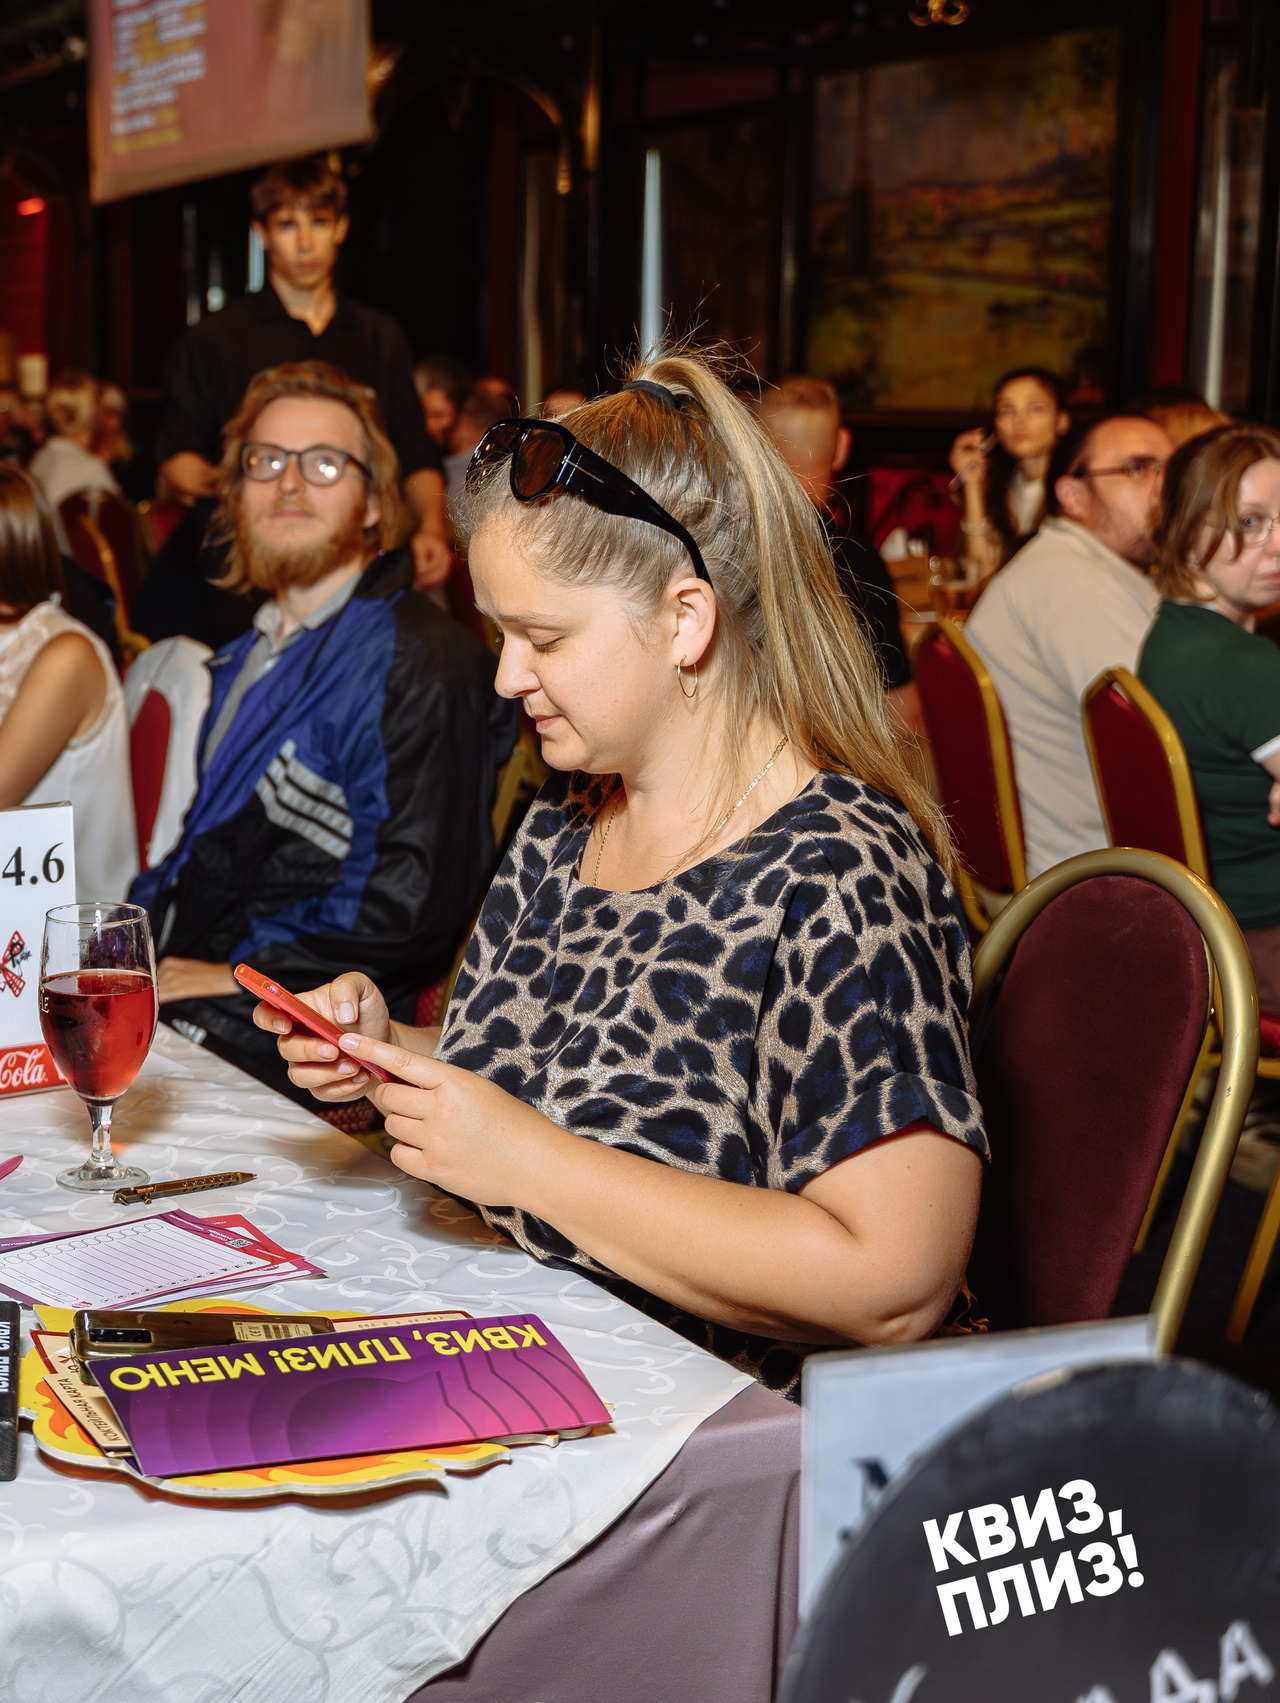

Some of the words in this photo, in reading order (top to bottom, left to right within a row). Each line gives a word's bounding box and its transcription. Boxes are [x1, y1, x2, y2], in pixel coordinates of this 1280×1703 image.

[2, 842, 65, 886] 4.6
[268, 1337, 413, 1374] ПЛИЗ!
[413, 1324, 547, 1356] КВИЗ,
[57, 1378, 83, 1397] КАРТА
[109, 1352, 267, 1391] МЕНЮ
